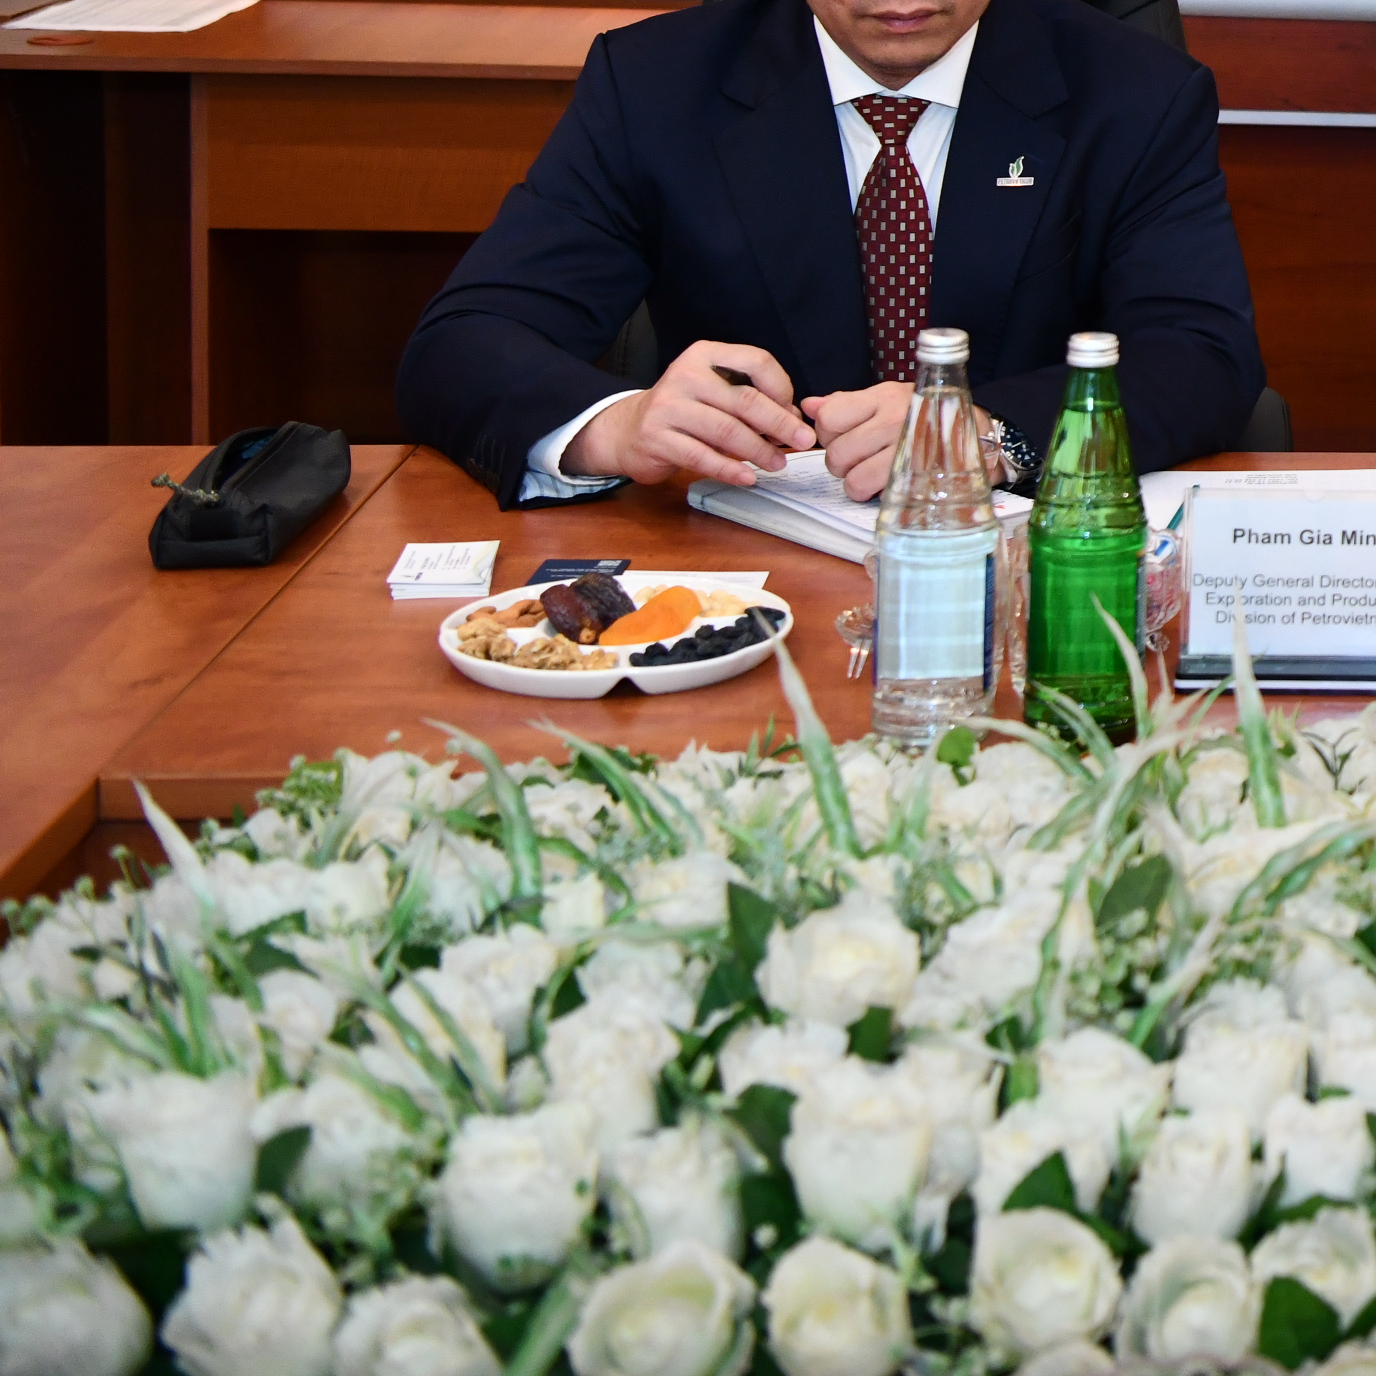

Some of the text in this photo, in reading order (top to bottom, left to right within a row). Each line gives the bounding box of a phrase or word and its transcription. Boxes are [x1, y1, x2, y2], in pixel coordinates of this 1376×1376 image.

[1233, 528, 1291, 545] Pham
[1300, 529, 1333, 545] Gia
[1193, 574, 1247, 591] Deputy
[1253, 574, 1314, 589] General
[1205, 592, 1292, 609] Exporation
[1297, 593, 1326, 607] and
[1216, 610, 1276, 624] Divsion
[1281, 611, 1296, 625] of
